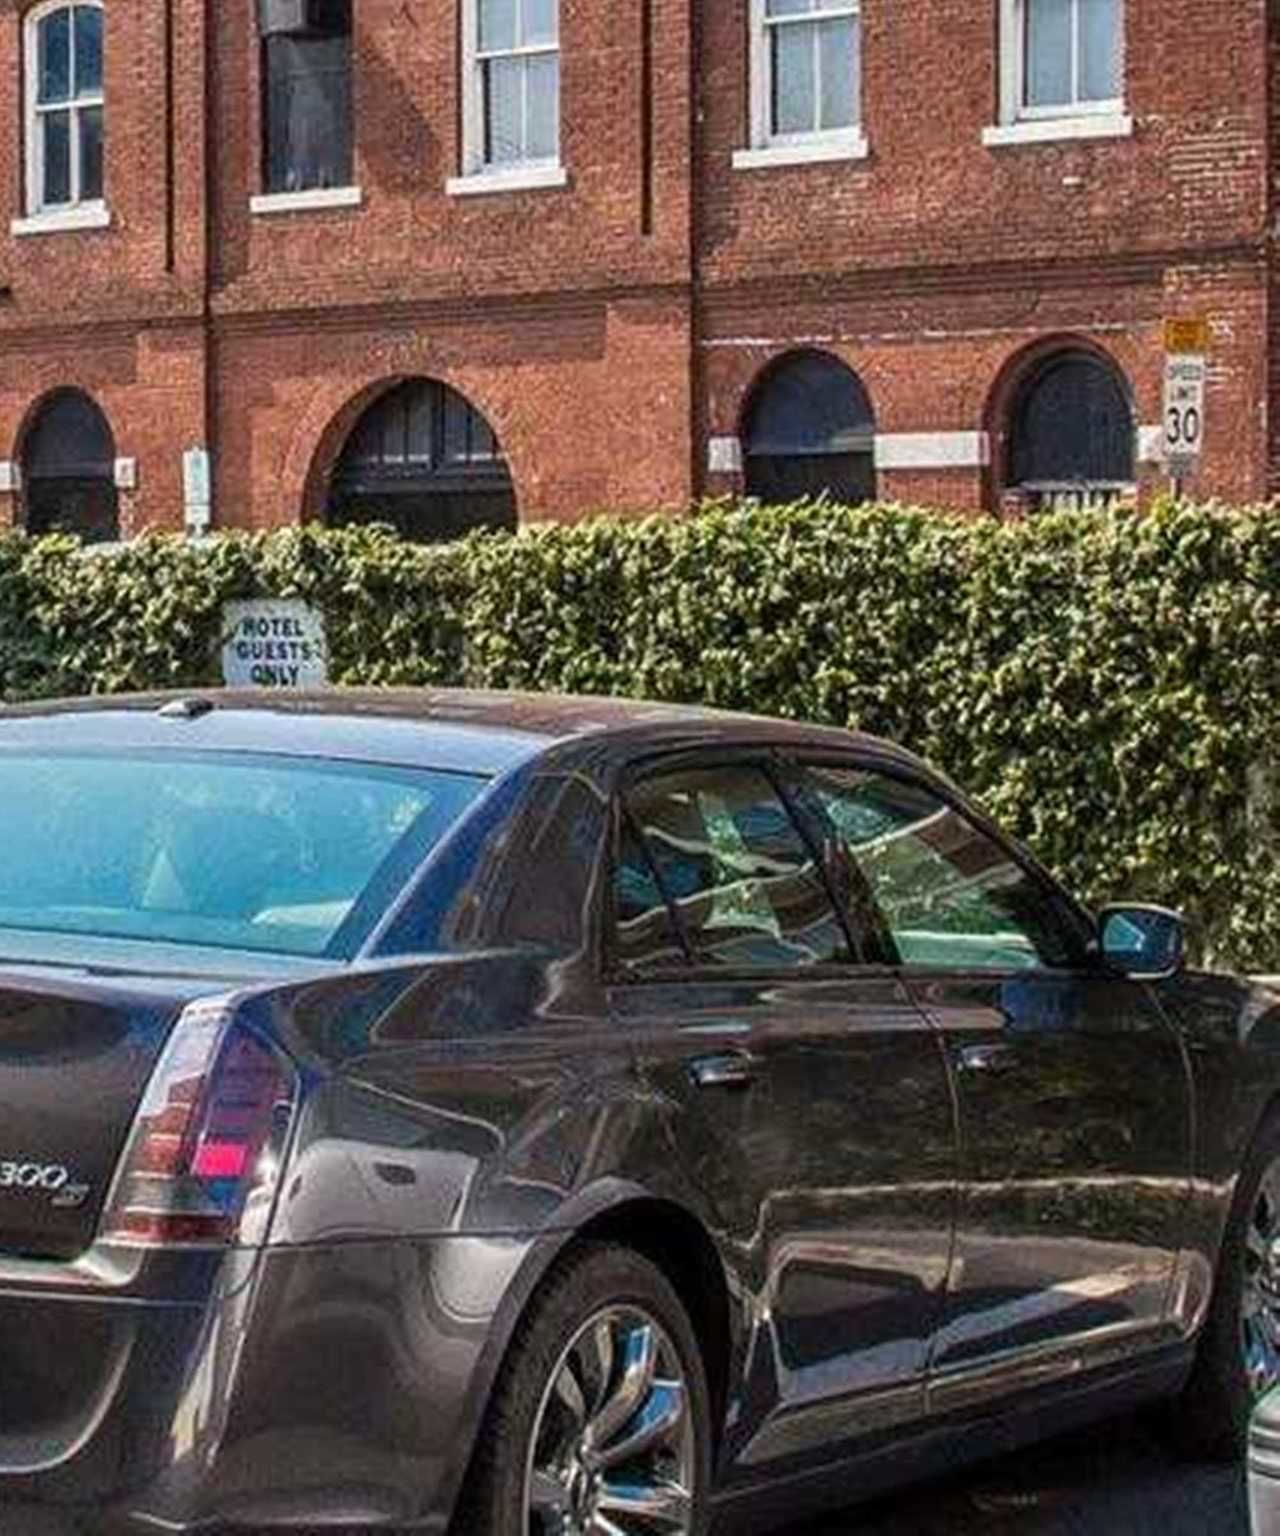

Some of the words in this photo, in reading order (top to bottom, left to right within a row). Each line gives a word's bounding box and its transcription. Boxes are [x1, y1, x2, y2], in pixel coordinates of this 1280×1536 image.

[1167, 405, 1200, 444] 30
[236, 641, 312, 661] GUESTS
[250, 663, 300, 686] ONLY
